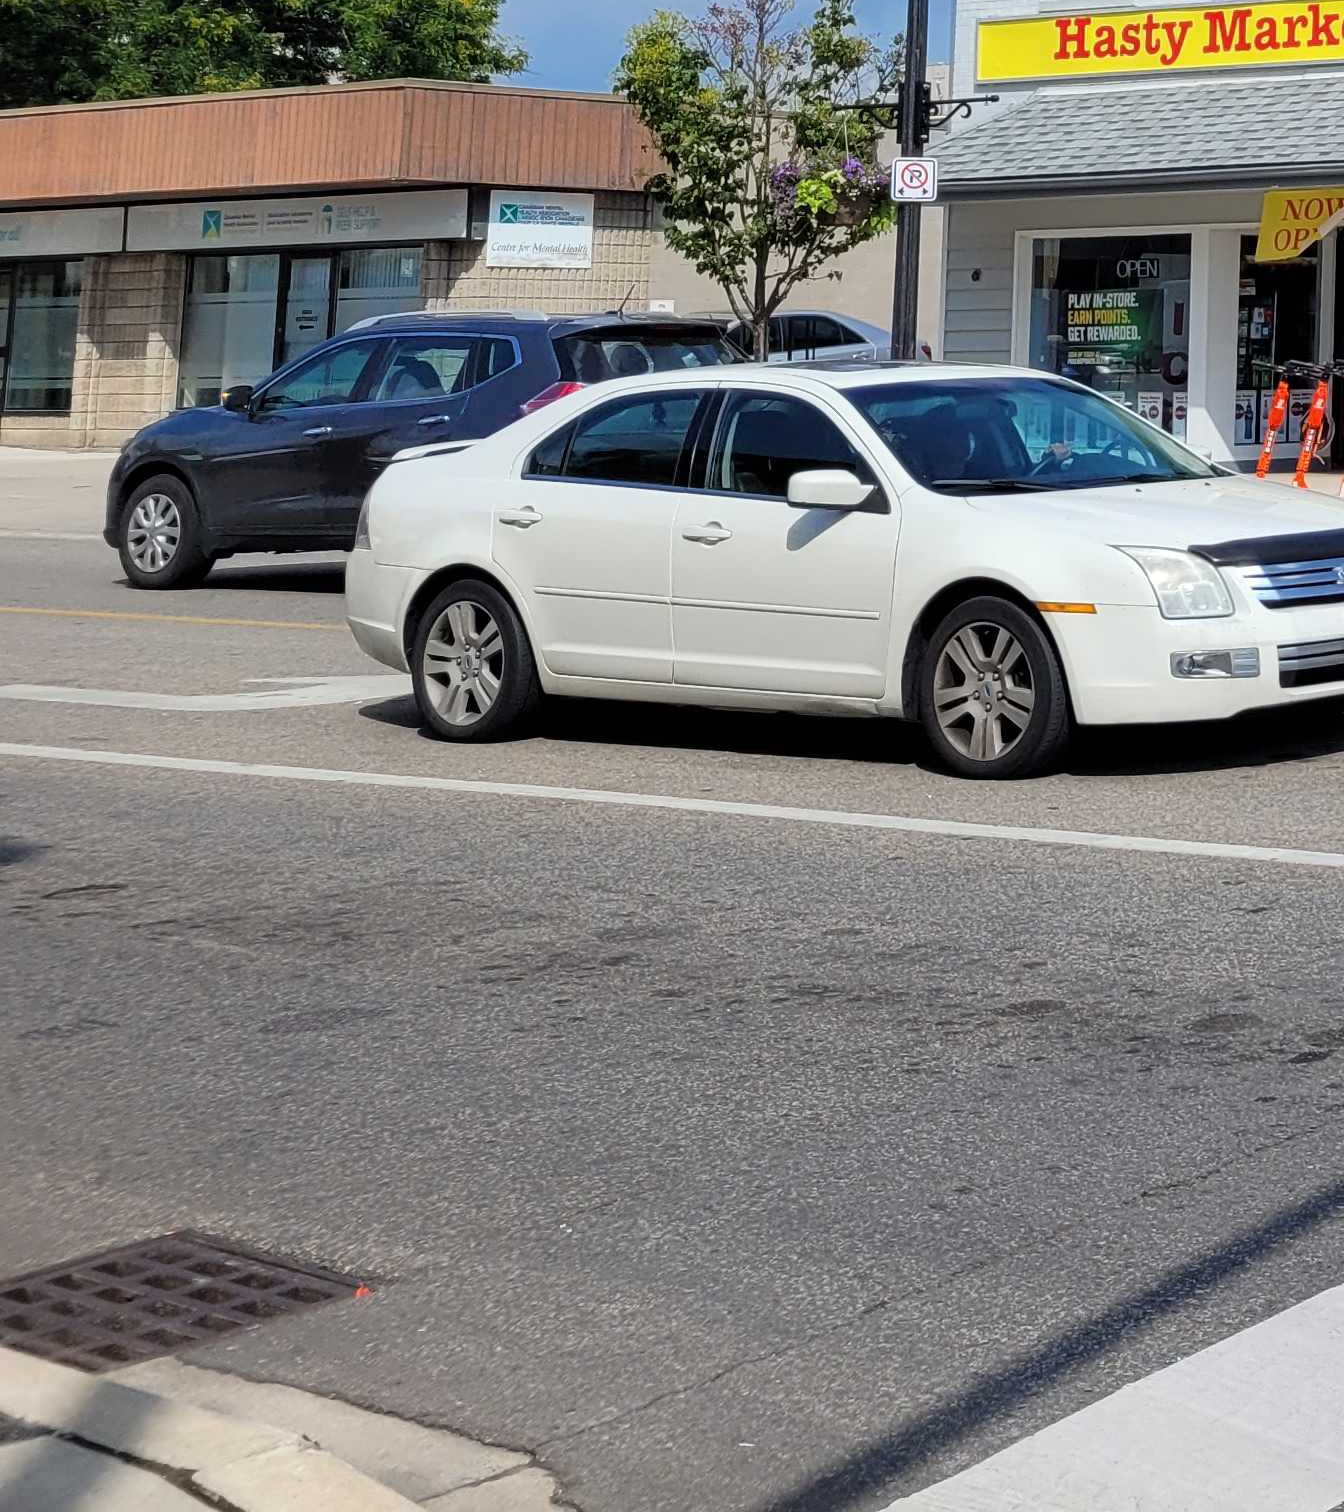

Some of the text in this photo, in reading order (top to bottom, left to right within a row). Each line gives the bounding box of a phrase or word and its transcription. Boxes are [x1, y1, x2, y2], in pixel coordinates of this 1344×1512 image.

[1053, 13, 1193, 65] Hasty
[1274, 227, 1318, 252] OP
[1116, 259, 1159, 278] OPEN
[1068, 292, 1139, 309] PLAY IN-STORE.
[1068, 309, 1131, 325] EARN POINTS.
[1068, 325, 1141, 342] GET REWARDED.
